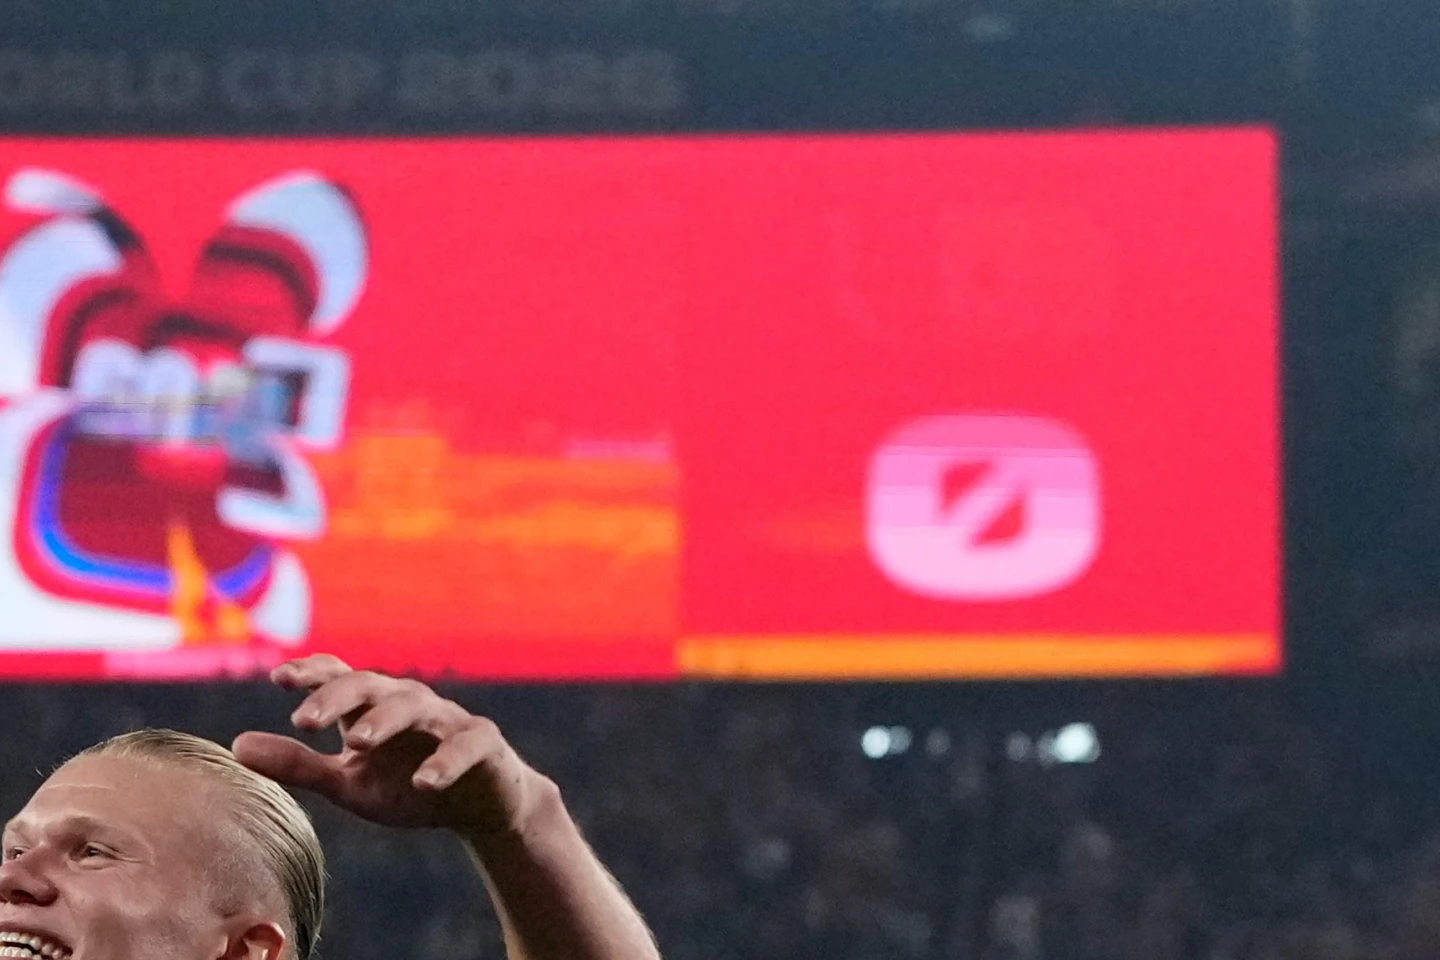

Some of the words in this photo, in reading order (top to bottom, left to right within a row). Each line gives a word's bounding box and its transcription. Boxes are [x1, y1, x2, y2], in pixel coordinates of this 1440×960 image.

[220, 50, 385, 113] CUP
[397, 50, 681, 112] 2026
[864, 413, 1101, 600] 0
